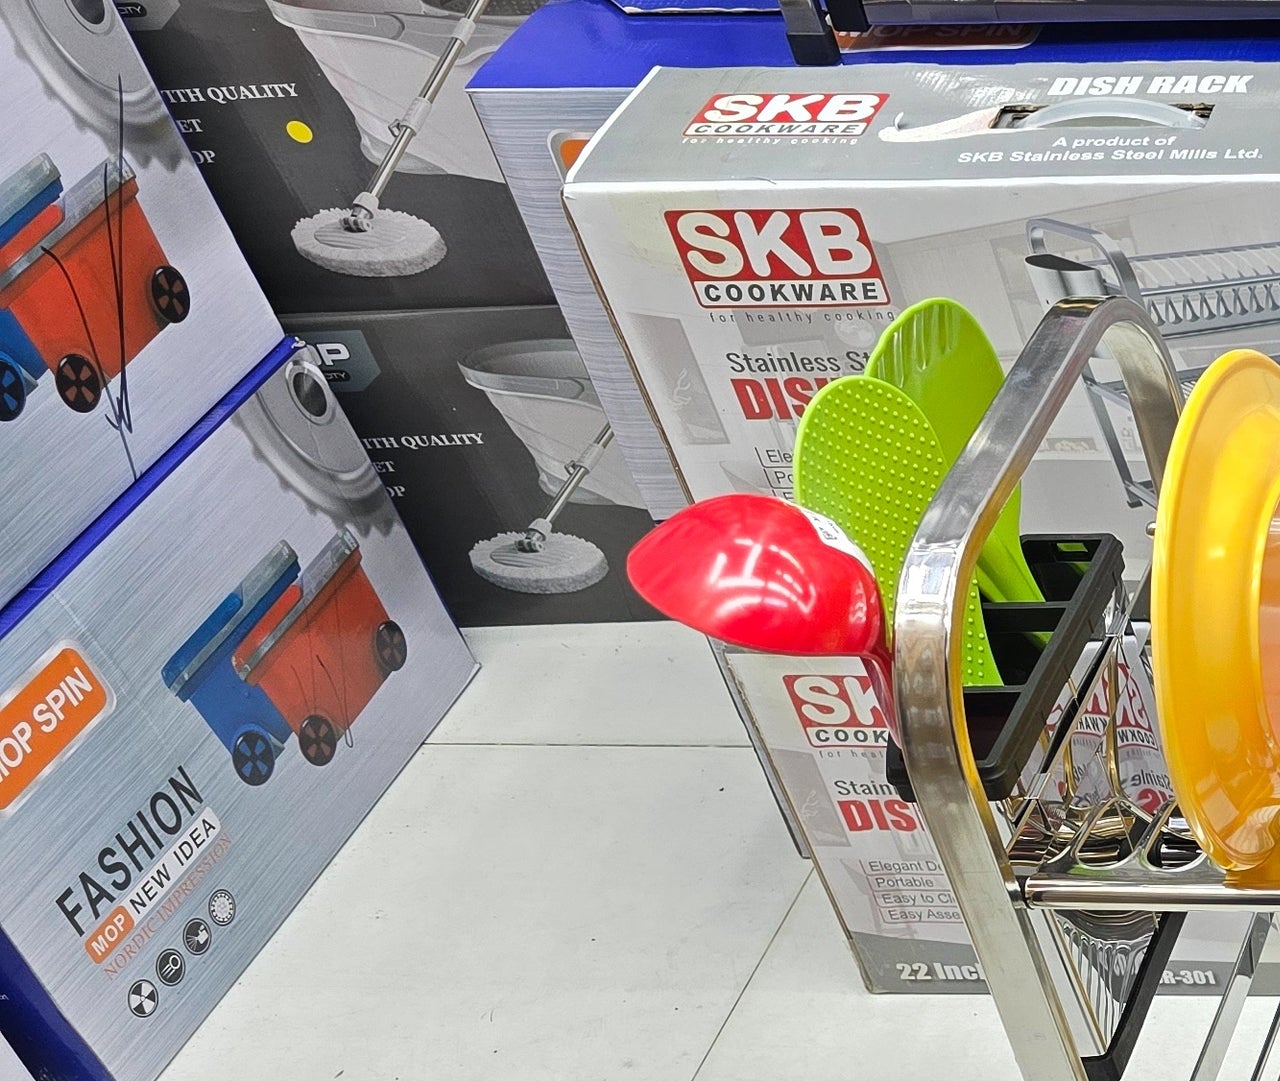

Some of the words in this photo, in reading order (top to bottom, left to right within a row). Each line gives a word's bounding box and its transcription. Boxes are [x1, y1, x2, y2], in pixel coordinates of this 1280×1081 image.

[161, 88, 206, 104] ITH
[207, 83, 298, 104] QUALITY
[1047, 76, 1143, 95] DISH
[1146, 75, 1254, 94] RACK
[704, 94, 880, 122] SKB
[694, 124, 860, 134] COOKWARE
[682, 137, 706, 145] for
[716, 137, 781, 145] healthy
[791, 137, 858, 145] cooking
[1052, 136, 1068, 147] A
[1072, 136, 1150, 149] product
[1154, 136, 1177, 147] of
[957, 152, 1003, 163] SKB
[1009, 151, 1108, 162] Stainless
[1111, 149, 1163, 160] Steel
[1169, 149, 1217, 160] Mills
[1224, 149, 1263, 160] Ltd.
[677, 211, 872, 278] SKB
[704, 282, 878, 302] COOKWARE
[710, 312, 735, 323] for
[745, 311, 812, 324] healthy
[824, 310, 895, 322] cooking
[726, 352, 841, 373] Stainless
[730, 376, 836, 420] DIS
[360, 436, 400, 449] ITH
[401, 433, 484, 450] QUALITY
[32, 666, 93, 733] SPIN
[793, 676, 886, 725] SK
[815, 729, 889, 743] COOK
[0, 721, 32, 783] OP
[850, 750, 884, 758] heal
[837, 799, 924, 832] DIS
[55, 765, 203, 937] FASHION
[869, 861, 924, 873] Elegant
[91, 913, 127, 956] MOP
[129, 863, 171, 914] NEW
[173, 818, 216, 866] IDEA
[875, 877, 934, 888] Portable
[103, 920, 155, 981] NORDIC
[155, 832, 233, 924] IMPRESSION
[881, 893, 916, 906] Easy
[922, 893, 934, 904] to
[888, 909, 922, 922] Easy
[927, 909, 961, 920] Asse
[896, 962, 932, 980] 22
[1159, 969, 1216, 985] R-301
